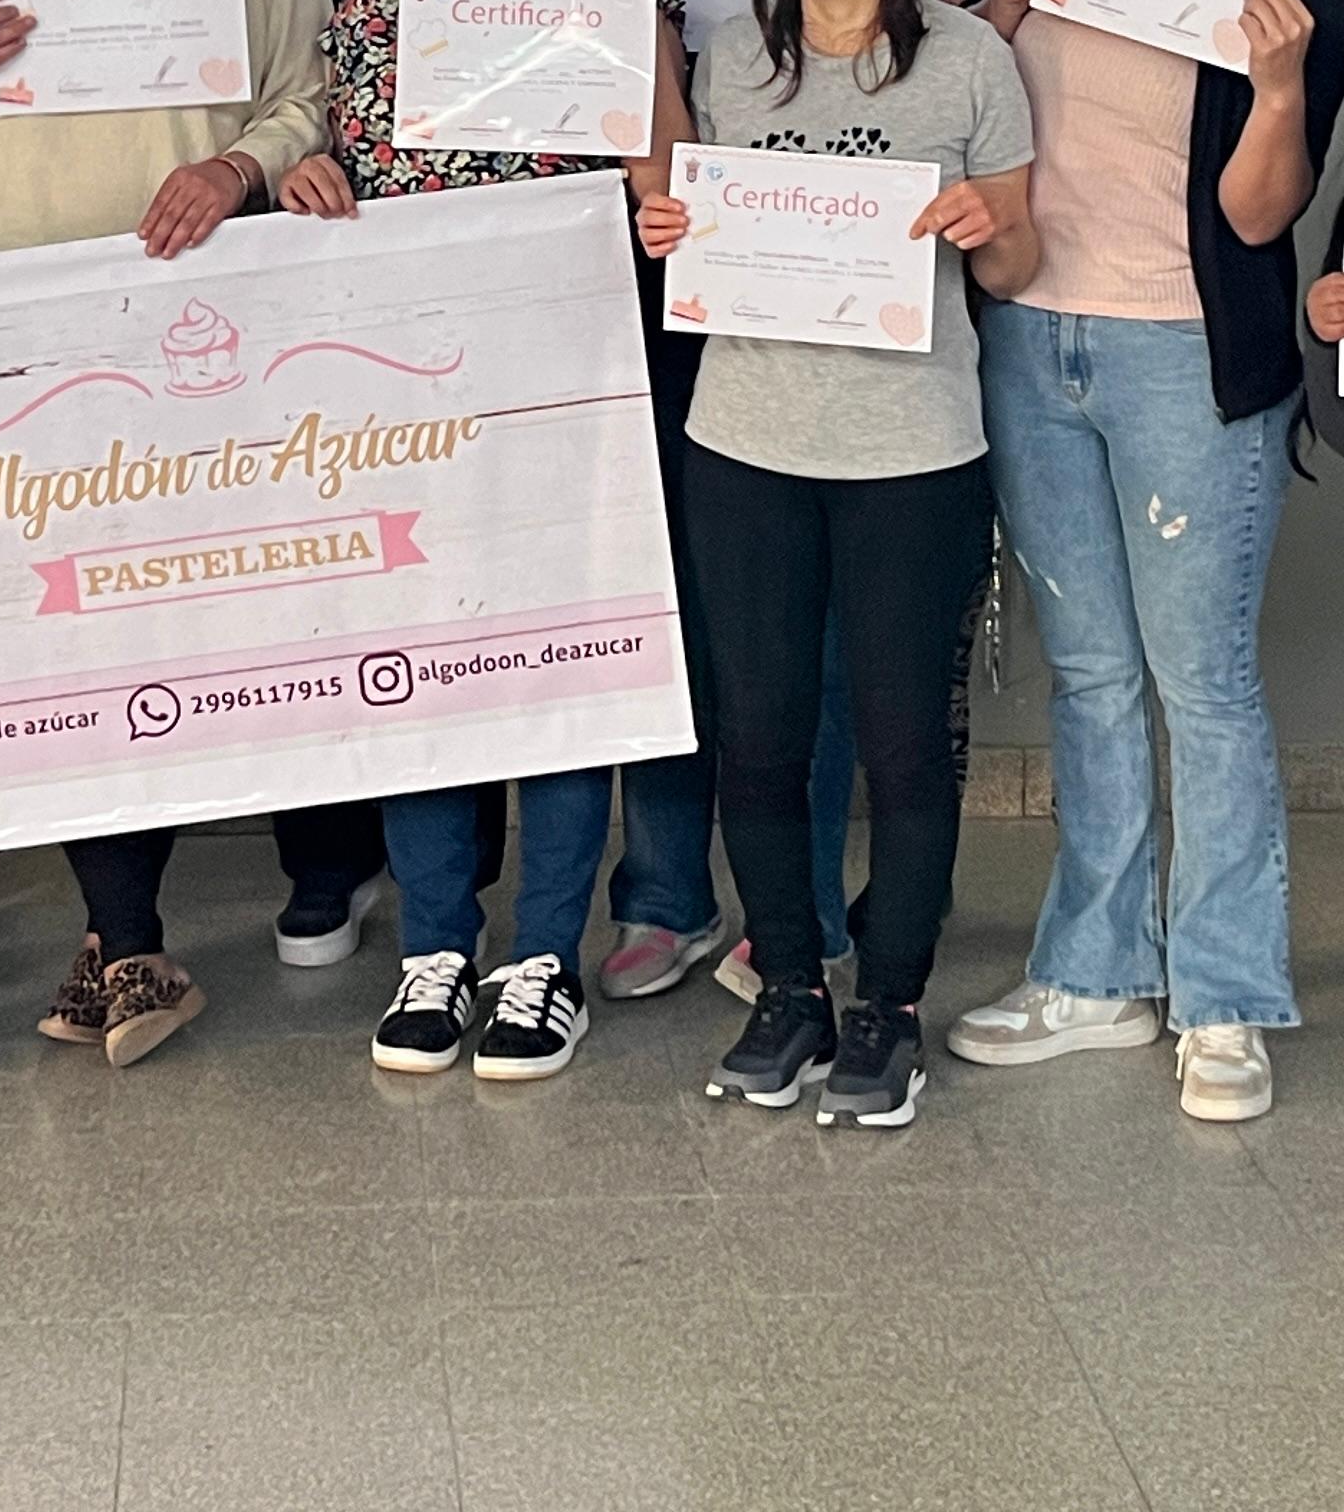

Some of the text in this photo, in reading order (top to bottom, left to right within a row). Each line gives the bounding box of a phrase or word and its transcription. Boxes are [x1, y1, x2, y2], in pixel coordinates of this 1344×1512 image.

[722, 182, 879, 218] Certificado
[207, 438, 262, 489] de
[269, 412, 482, 500] Azúcar
[83, 531, 375, 597] PASTELERIA
[417, 634, 644, 685] algodoon_deazucar
[190, 675, 344, 715] 2996117915
[23, 708, 100, 735] azúcar
